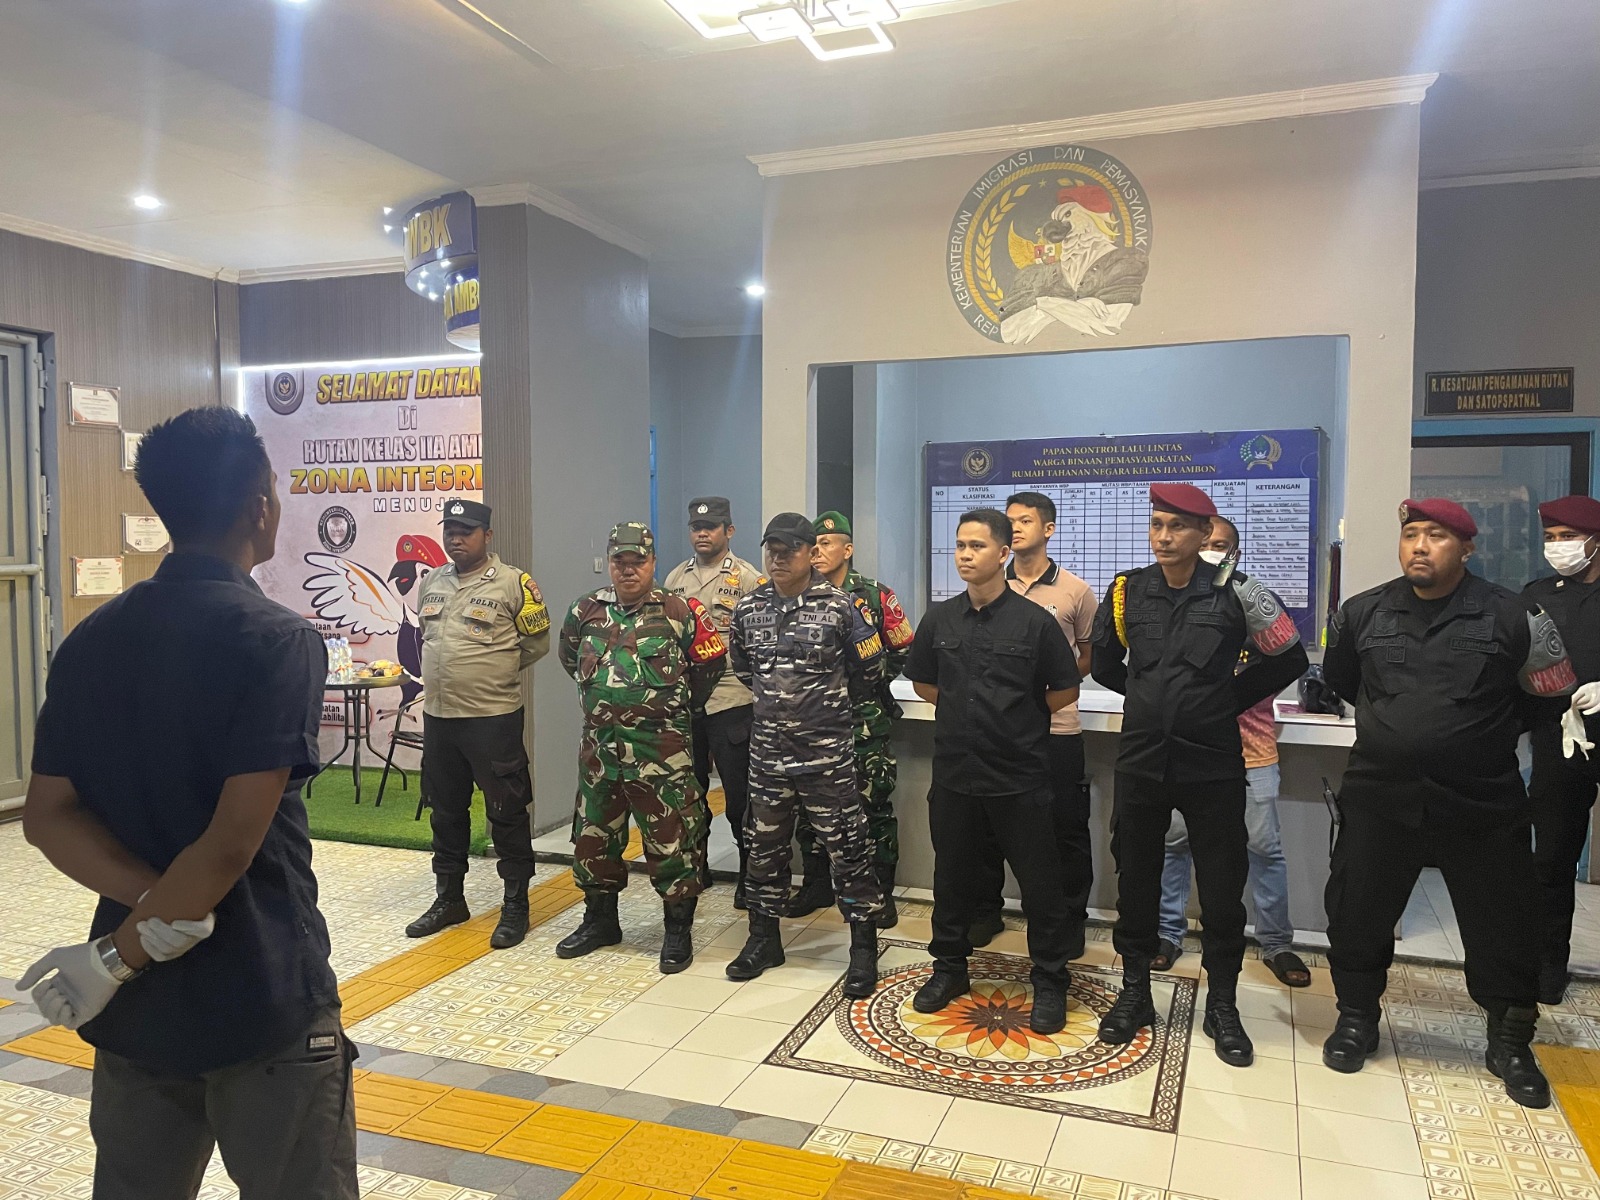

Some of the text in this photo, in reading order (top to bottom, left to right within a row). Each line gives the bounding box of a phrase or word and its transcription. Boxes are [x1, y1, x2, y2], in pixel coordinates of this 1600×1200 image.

[950, 210, 972, 310] KEMENTERIAN
[973, 151, 1033, 199] IMIGRASI
[1054, 146, 1085, 162] DAN
[973, 313, 999, 336] REP
[316, 370, 414, 405] SELAMAT
[1440, 376, 1482, 391] KESATUAN
[1484, 374, 1540, 390] PENGAMANAN
[1541, 373, 1569, 388] RUTAN
[1457, 393, 1541, 410] DAN SATOPSPATNAL
[398, 406, 417, 430] Di
[303, 438, 359, 464] RUTAN
[362, 436, 417, 462] KELAS
[419, 435, 447, 461] IIA
[1042, 443, 1182, 456] PAPAN KONTROL LALU LINTAS
[1033, 454, 1192, 467] WARGA BINAAN PEMASYARAKATAN
[1011, 465, 1216, 478] RUMAH TAHANAN NEGARA KELAS IIA AMBON
[290, 467, 372, 494] ZONA
[373, 496, 461, 513] MENUJ
[718, 587, 741, 598] POLRI
[469, 597, 499, 610] POLRI
[803, 613, 833, 623] TNI AL
